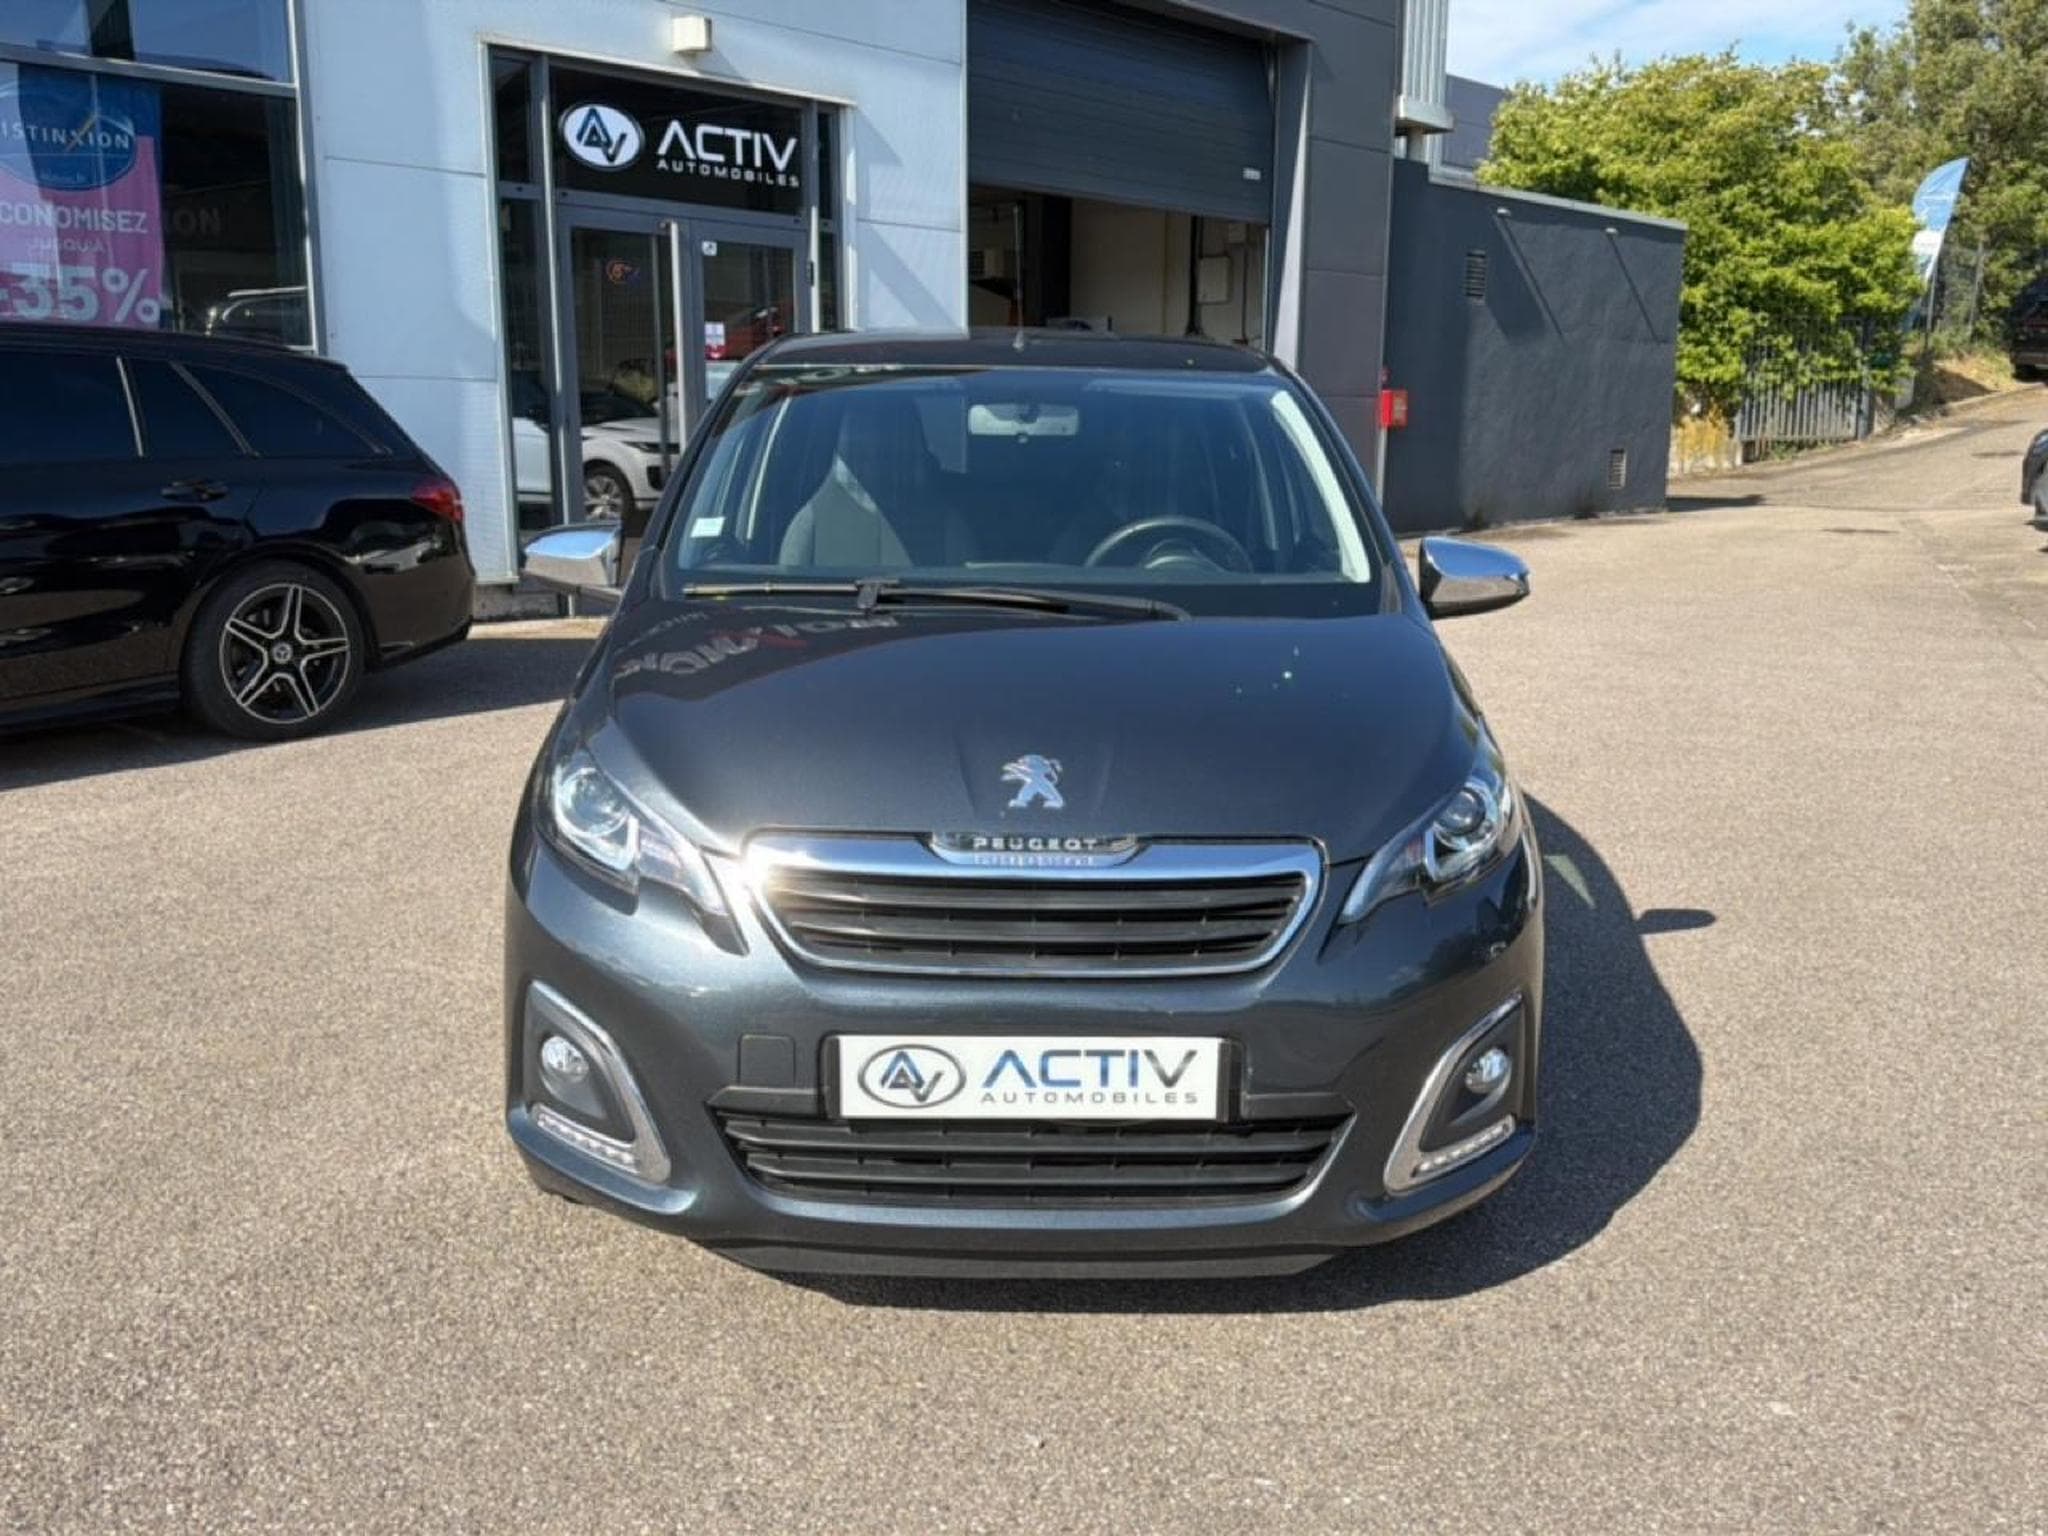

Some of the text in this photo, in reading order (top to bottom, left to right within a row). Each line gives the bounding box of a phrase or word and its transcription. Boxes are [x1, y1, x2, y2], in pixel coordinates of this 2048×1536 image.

[656, 119, 798, 172] ACTIV
[656, 159, 800, 188] AUTOMOBILES
[972, 836, 1098, 851] PEUGEOT
[980, 1049, 1198, 1088] ACTIV
[980, 1091, 1198, 1105] AUTOMOBILES
